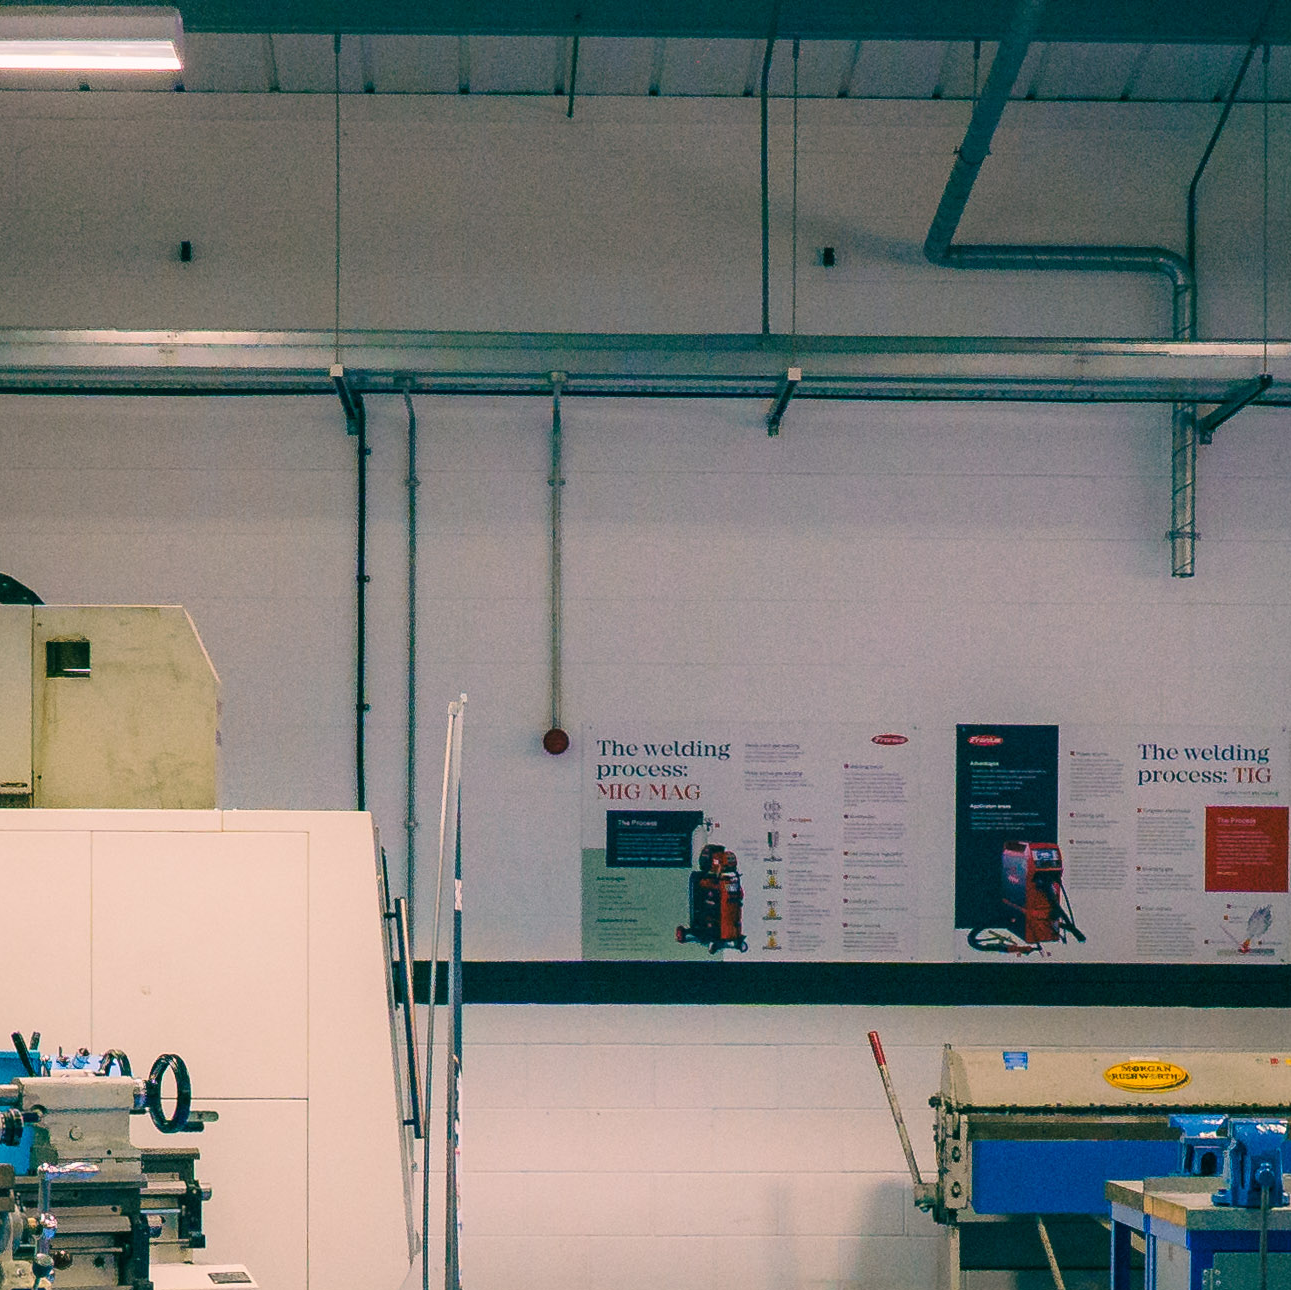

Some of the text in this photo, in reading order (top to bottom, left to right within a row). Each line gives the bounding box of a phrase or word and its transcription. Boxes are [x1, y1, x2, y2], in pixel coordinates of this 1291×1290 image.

[596, 739, 731, 761] The welding
[1137, 743, 1270, 764] The welding
[596, 763, 688, 780] process:
[1137, 766, 1272, 786] process: TIG
[1121, 1064, 1172, 1072] MORGAN
